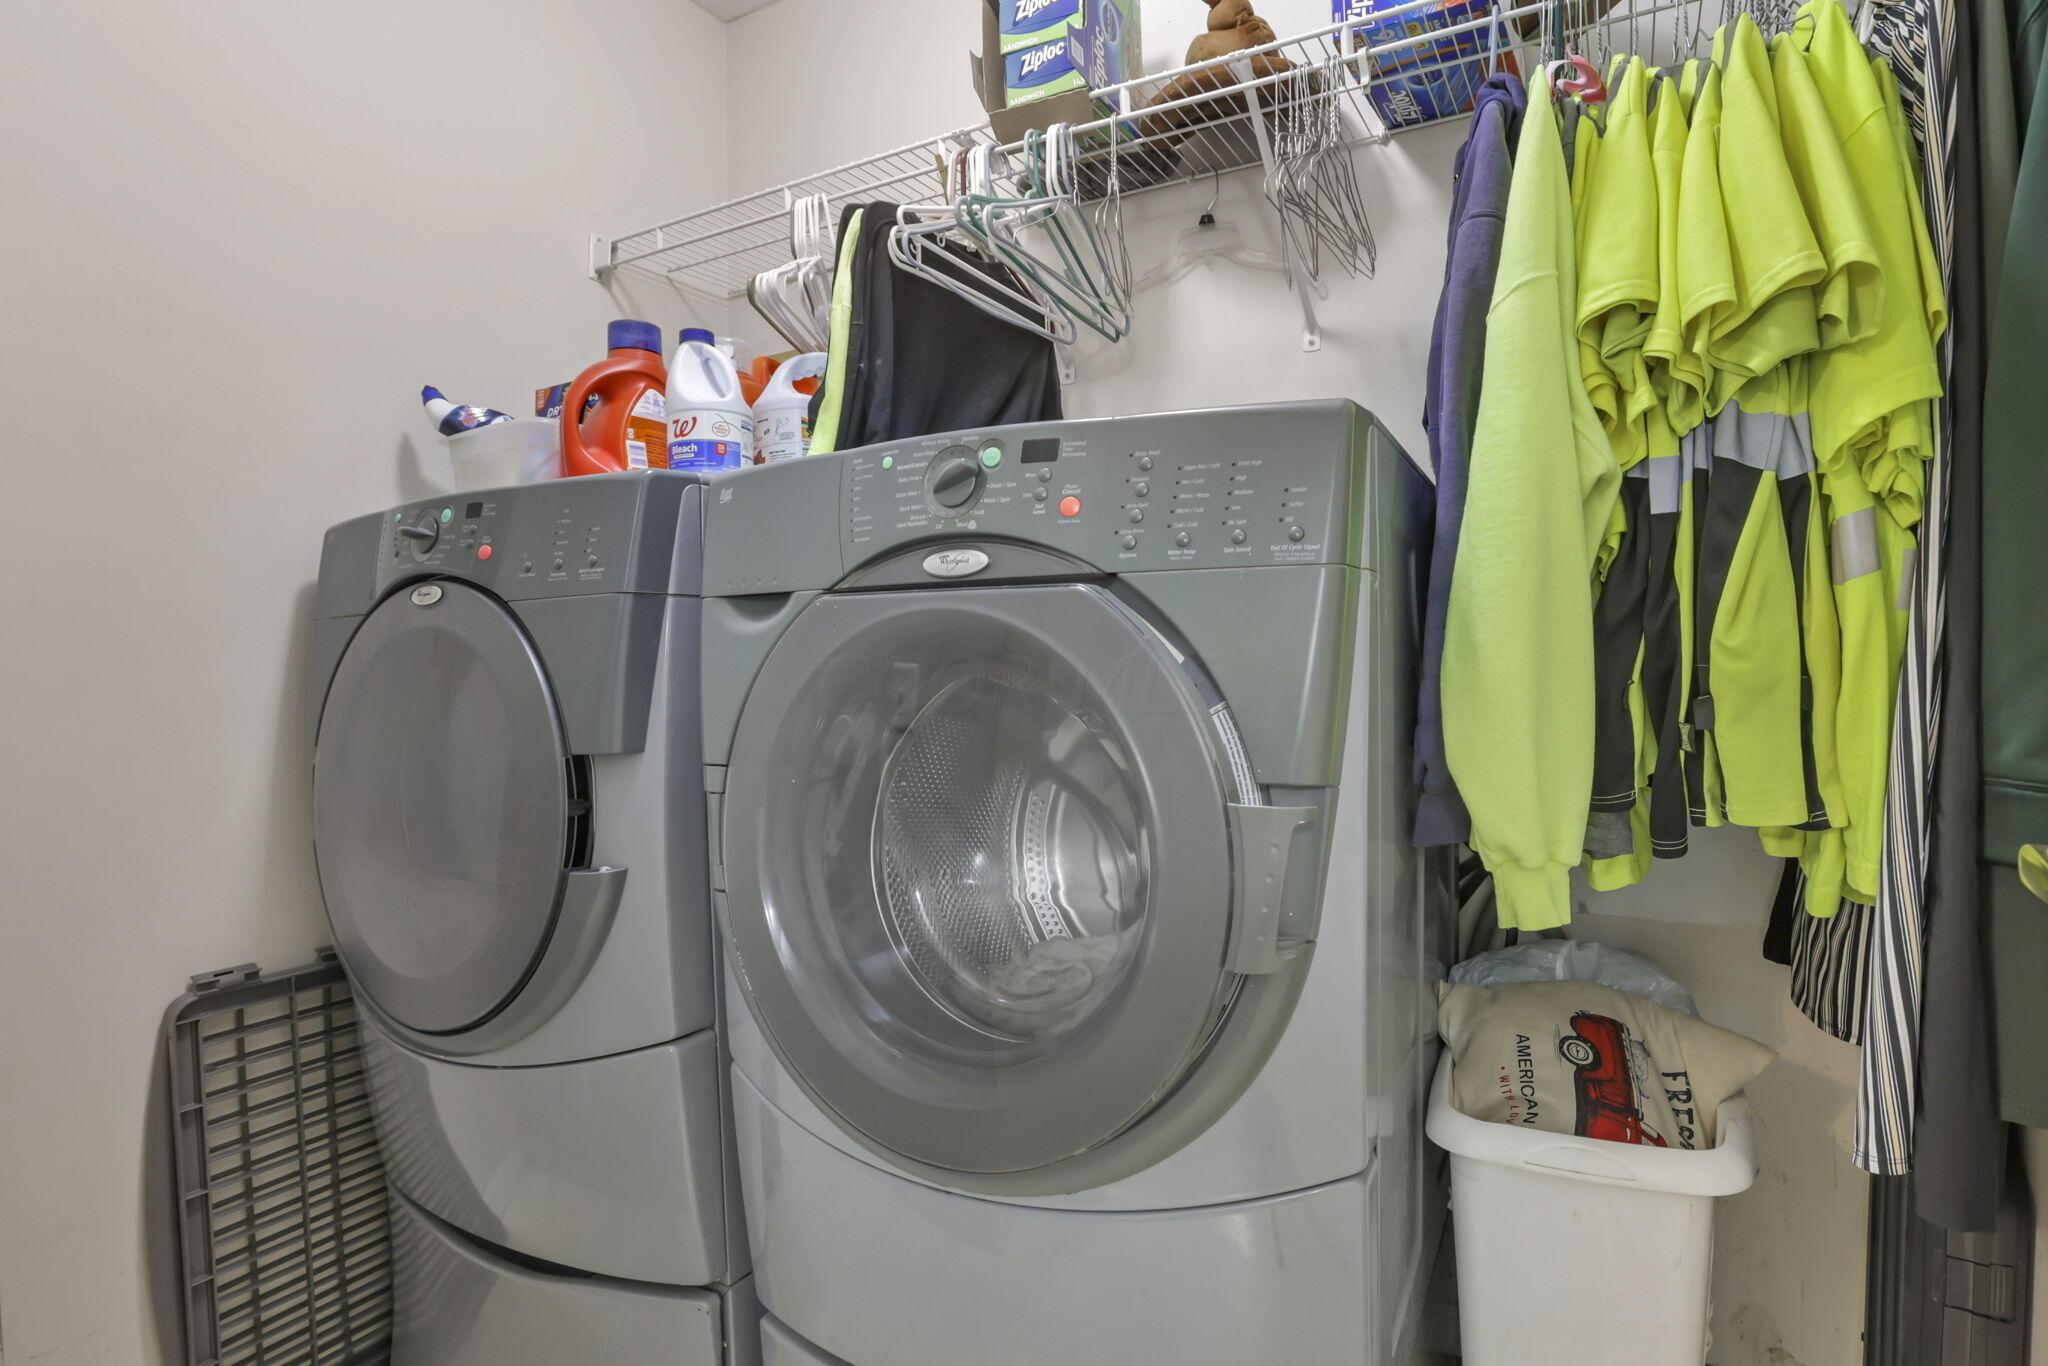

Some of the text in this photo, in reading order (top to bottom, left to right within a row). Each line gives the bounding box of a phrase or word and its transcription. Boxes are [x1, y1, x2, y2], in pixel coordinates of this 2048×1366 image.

[1021, 41, 1065, 76] Ziploc
[671, 443, 698, 455] Bleach
[1516, 1033, 1539, 1124] AMERICAN
